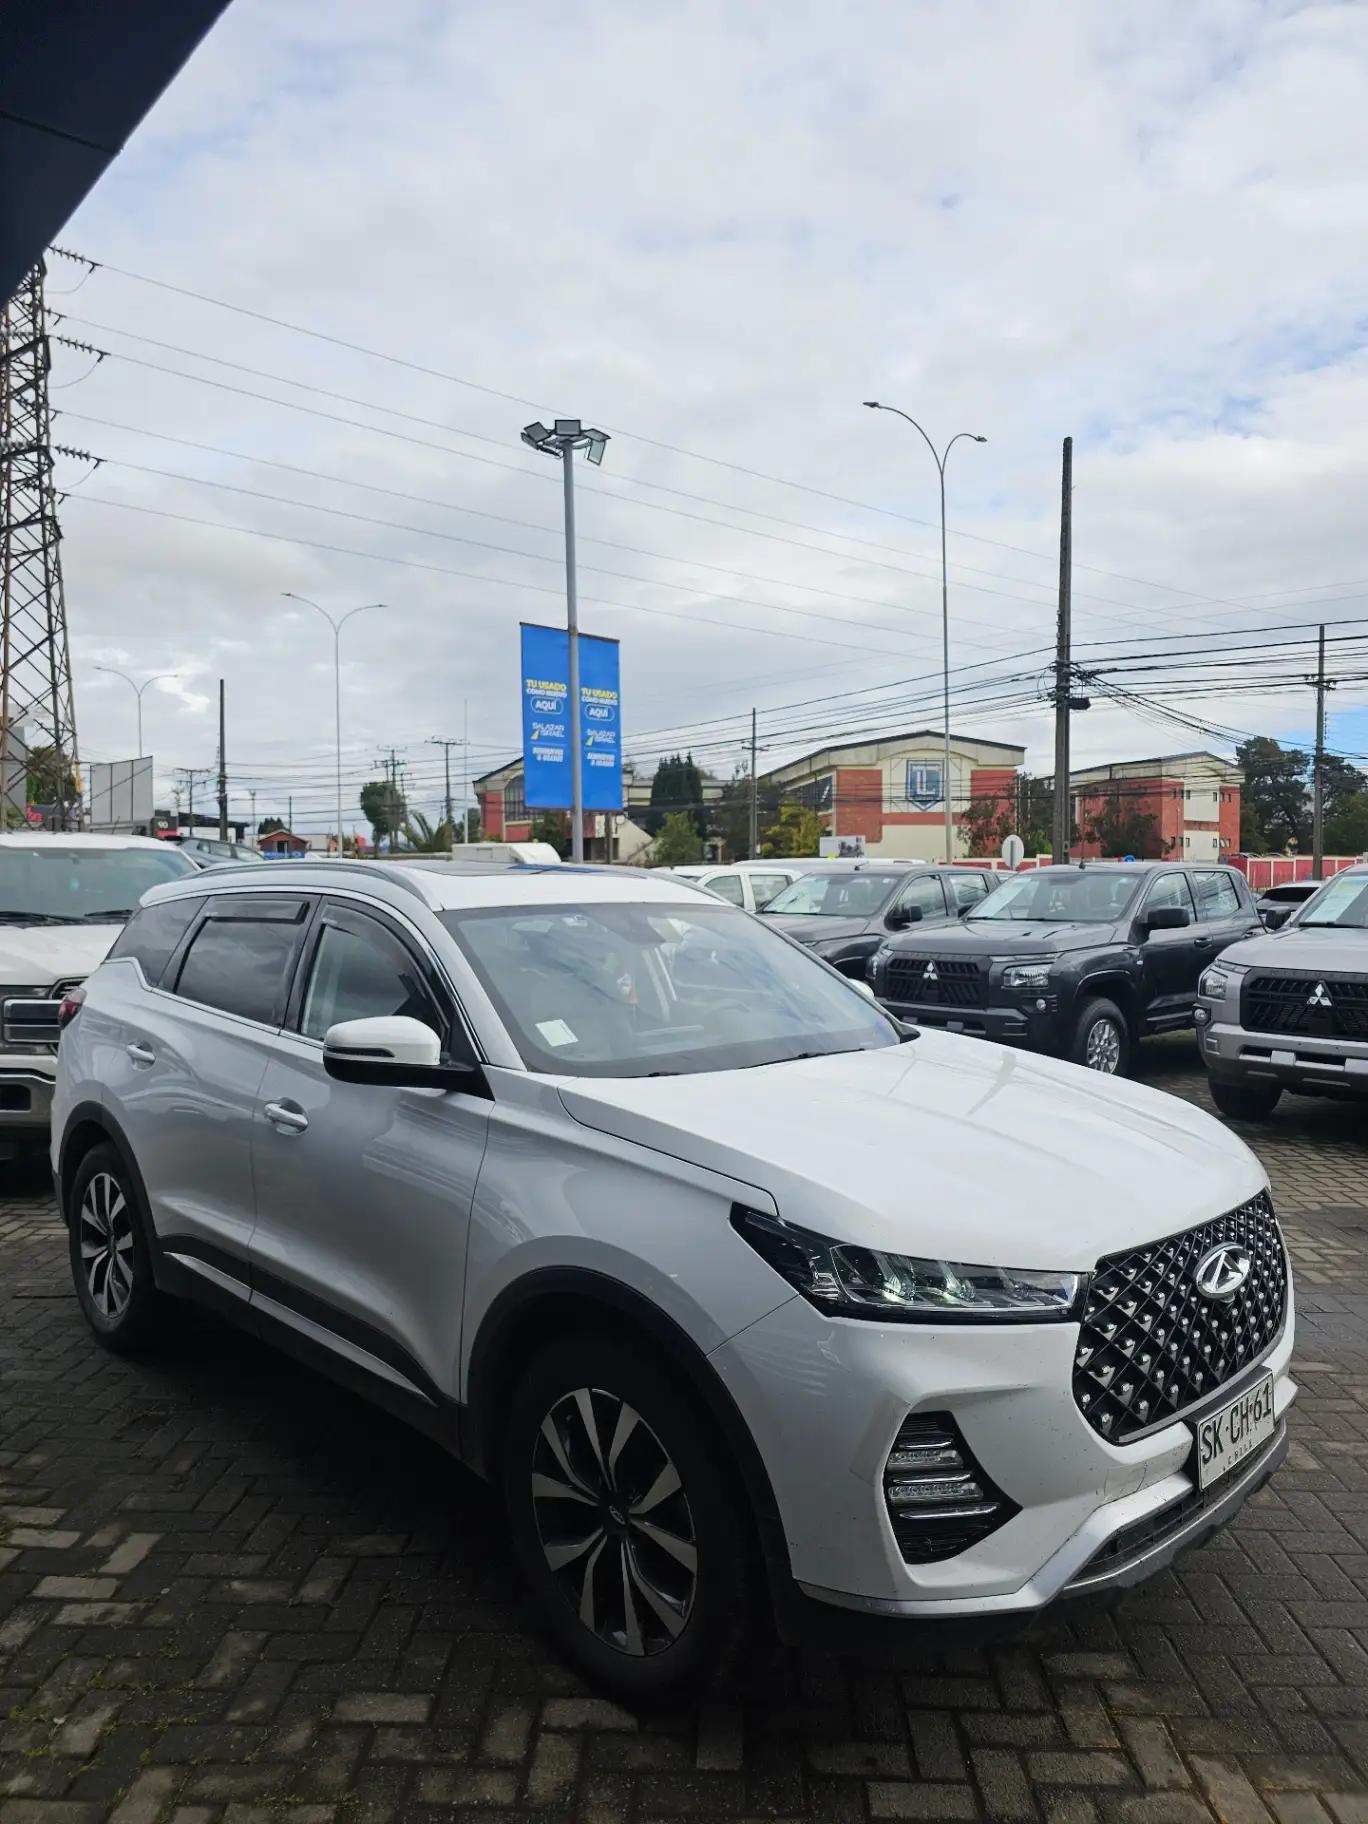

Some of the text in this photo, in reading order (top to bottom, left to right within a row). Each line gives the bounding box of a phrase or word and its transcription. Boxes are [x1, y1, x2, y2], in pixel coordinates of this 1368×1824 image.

[527, 680, 567, 692] TU USADO
[582, 688, 618, 699] TU USADO
